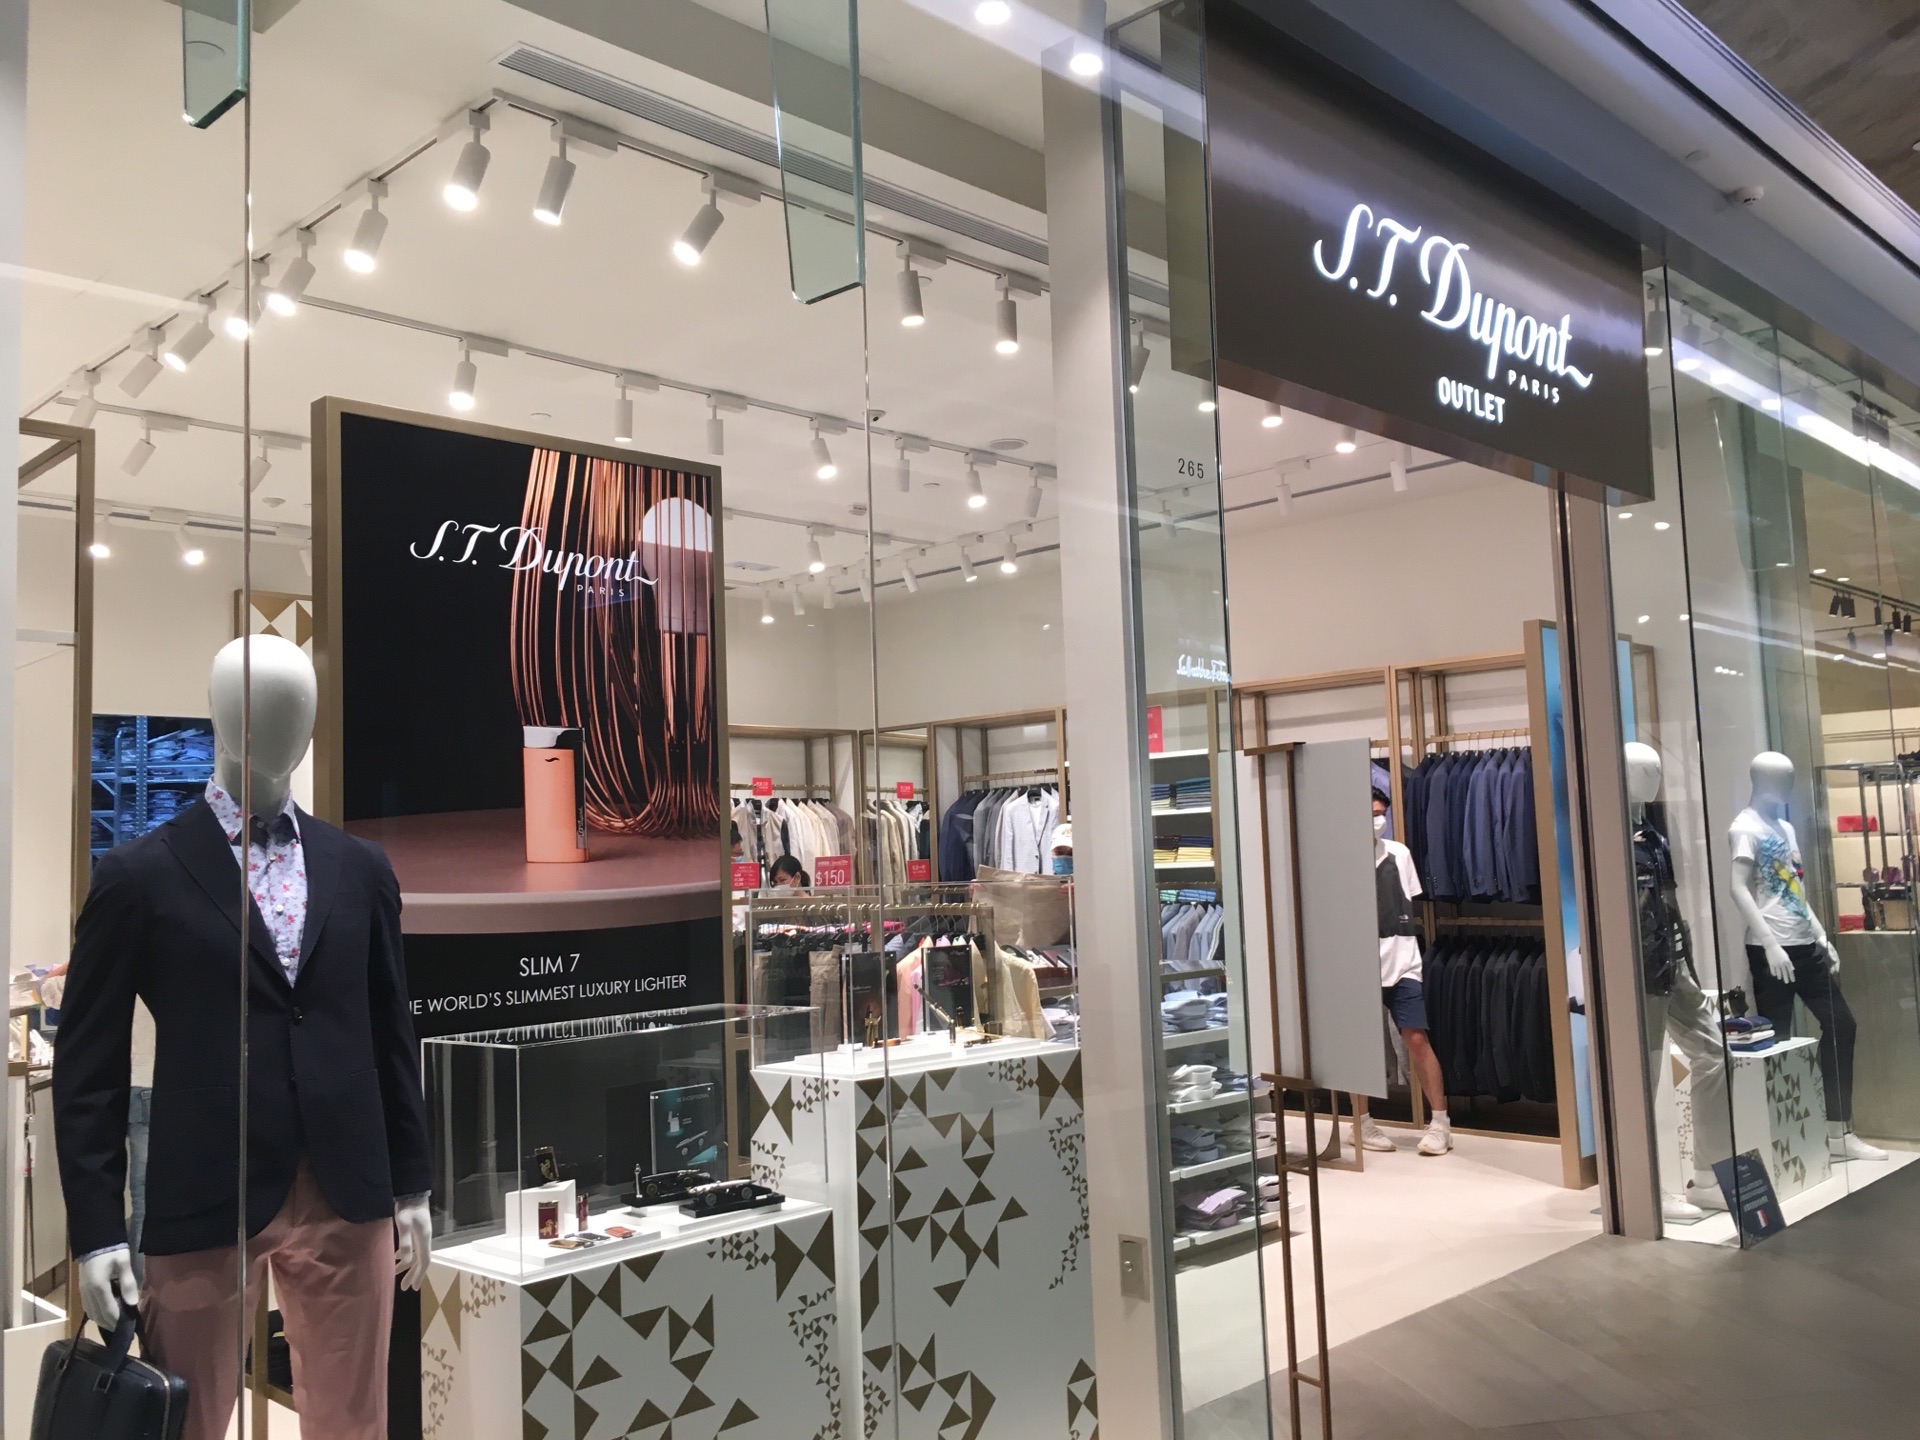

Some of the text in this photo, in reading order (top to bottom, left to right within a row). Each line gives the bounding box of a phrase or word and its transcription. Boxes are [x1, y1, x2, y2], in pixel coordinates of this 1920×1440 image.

[1313, 203, 1594, 388] S.T. Dupont
[1438, 376, 1506, 424] OUTLET
[1507, 369, 1560, 404] PARIS
[1178, 457, 1205, 479] 265
[409, 520, 659, 591] S.T. Dupont
[577, 584, 625, 597] PARIS
[815, 869, 845, 886] $150
[519, 953, 581, 977] SLIM 7
[427, 992, 501, 1013] WORLD'S
[506, 985, 576, 1006] SLIMMEST
[579, 979, 631, 998] LUXURY
[635, 974, 688, 992] LIGHTER
